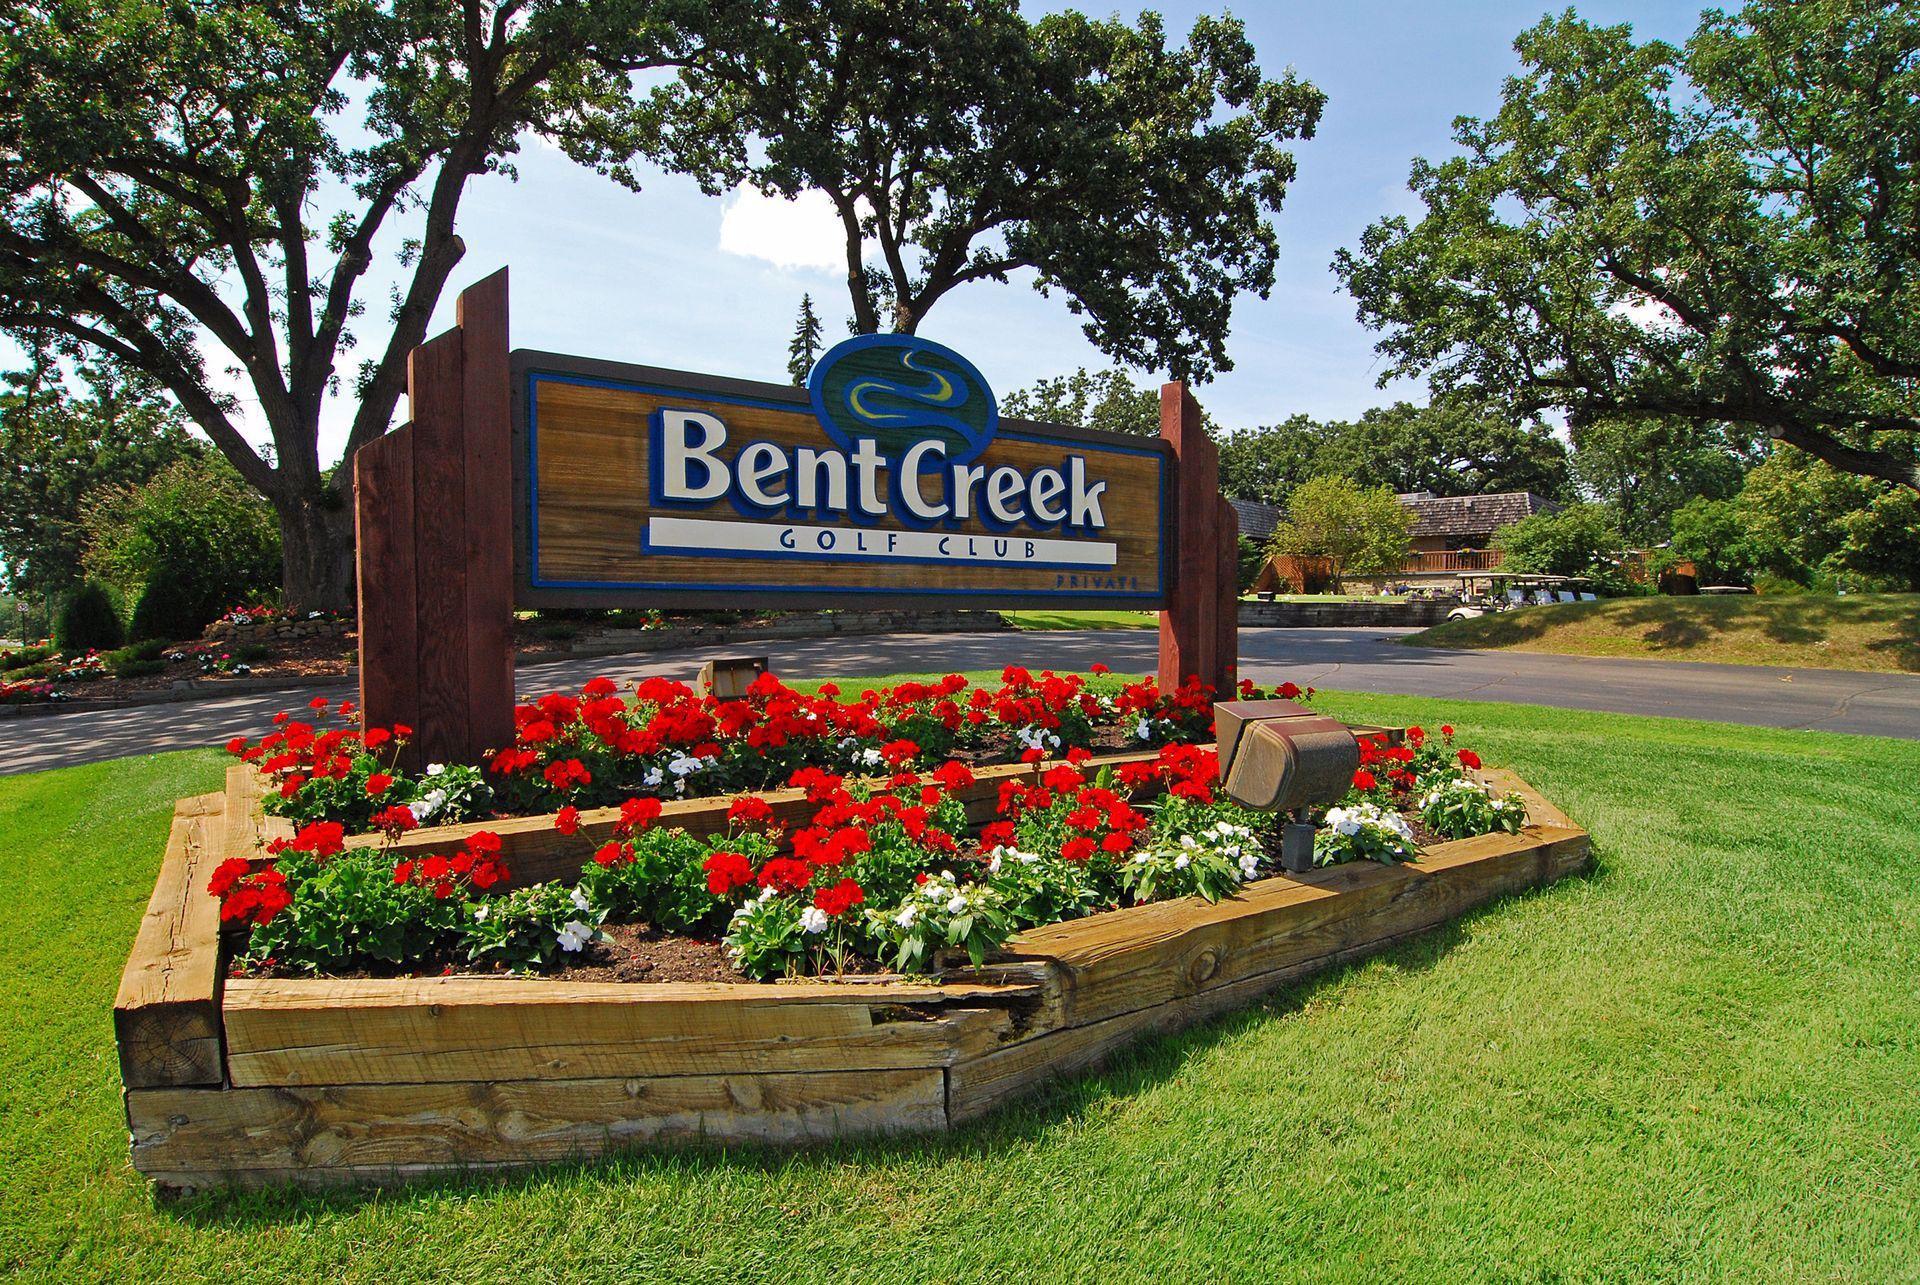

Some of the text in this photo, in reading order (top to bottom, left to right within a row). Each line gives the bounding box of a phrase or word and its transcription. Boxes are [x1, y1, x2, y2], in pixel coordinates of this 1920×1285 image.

[779, 528, 1035, 559] GOLF CLUB
[1056, 573, 1137, 590] PRIVATE
